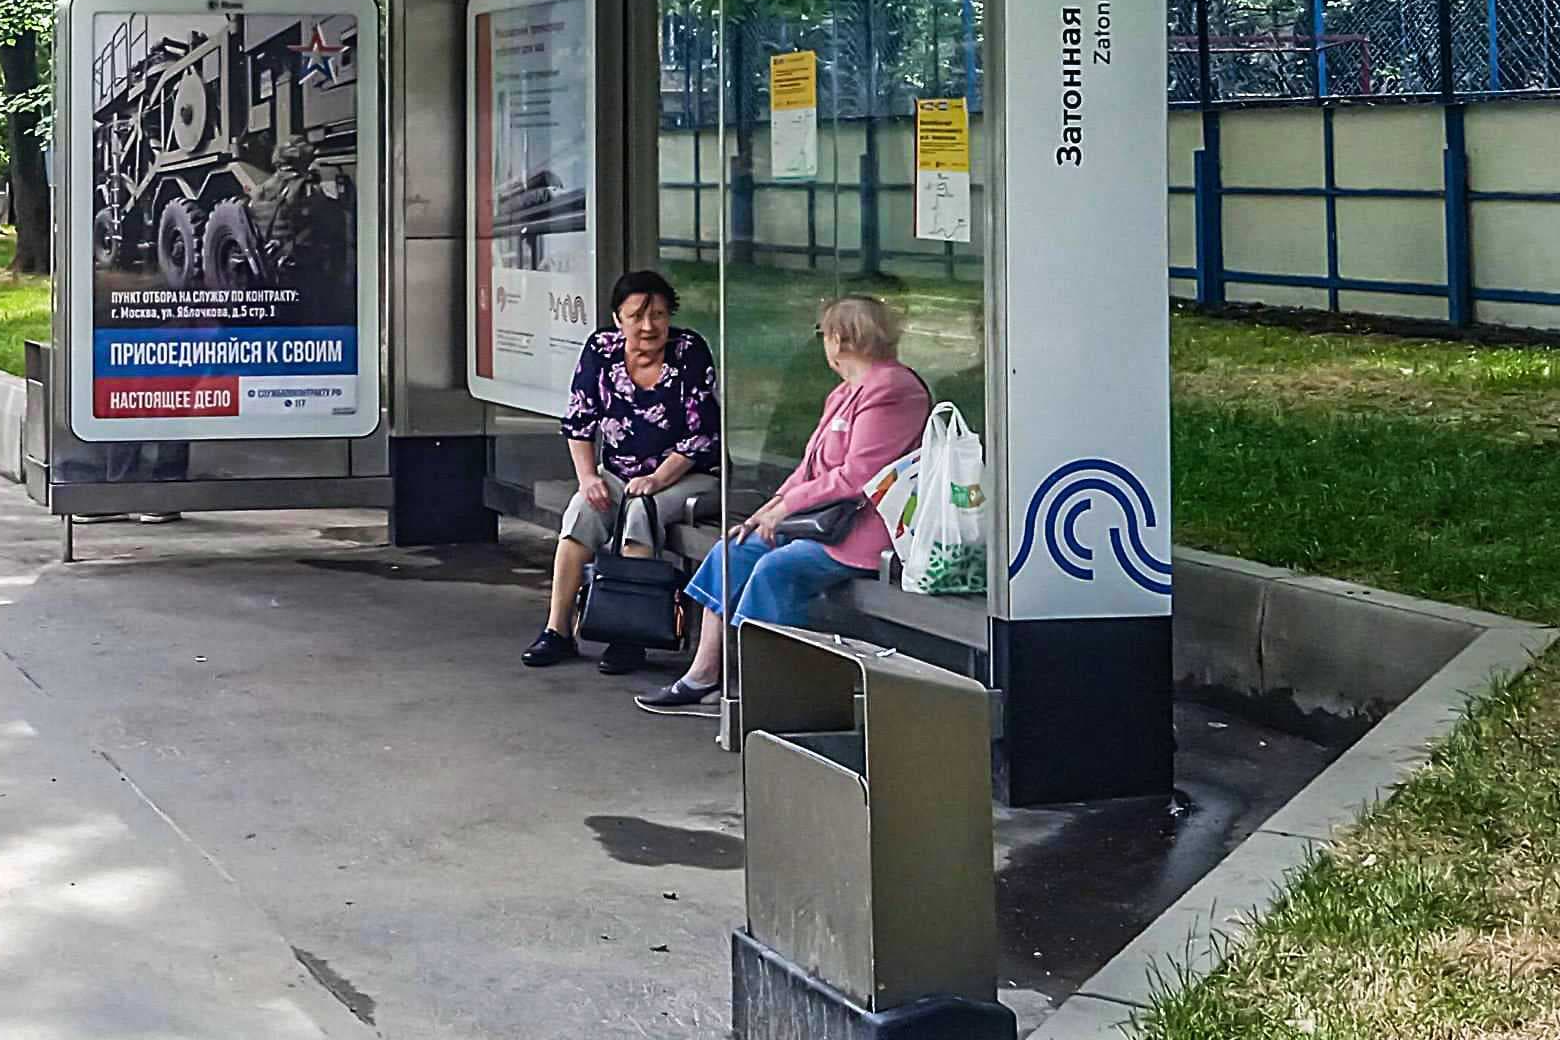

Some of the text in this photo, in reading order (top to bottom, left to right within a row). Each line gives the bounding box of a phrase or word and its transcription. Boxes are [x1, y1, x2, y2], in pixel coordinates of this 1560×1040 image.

[1055, 7, 1082, 167] Затонная
[111, 290, 300, 304] ПУНКТ ОТБОРА НА СЛУЖБУ ПО КОНТРАКТУ:
[111, 308, 119, 319] г.
[161, 308, 175, 321] ул.
[249, 306, 268, 320] стр.
[269, 305, 276, 317] 1
[110, 337, 342, 367] ПРИСОЕДИНЯЙСЯ К СВОИМ
[110, 390, 231, 410] НАСТОЯЩЕЕ ДЕЛО
